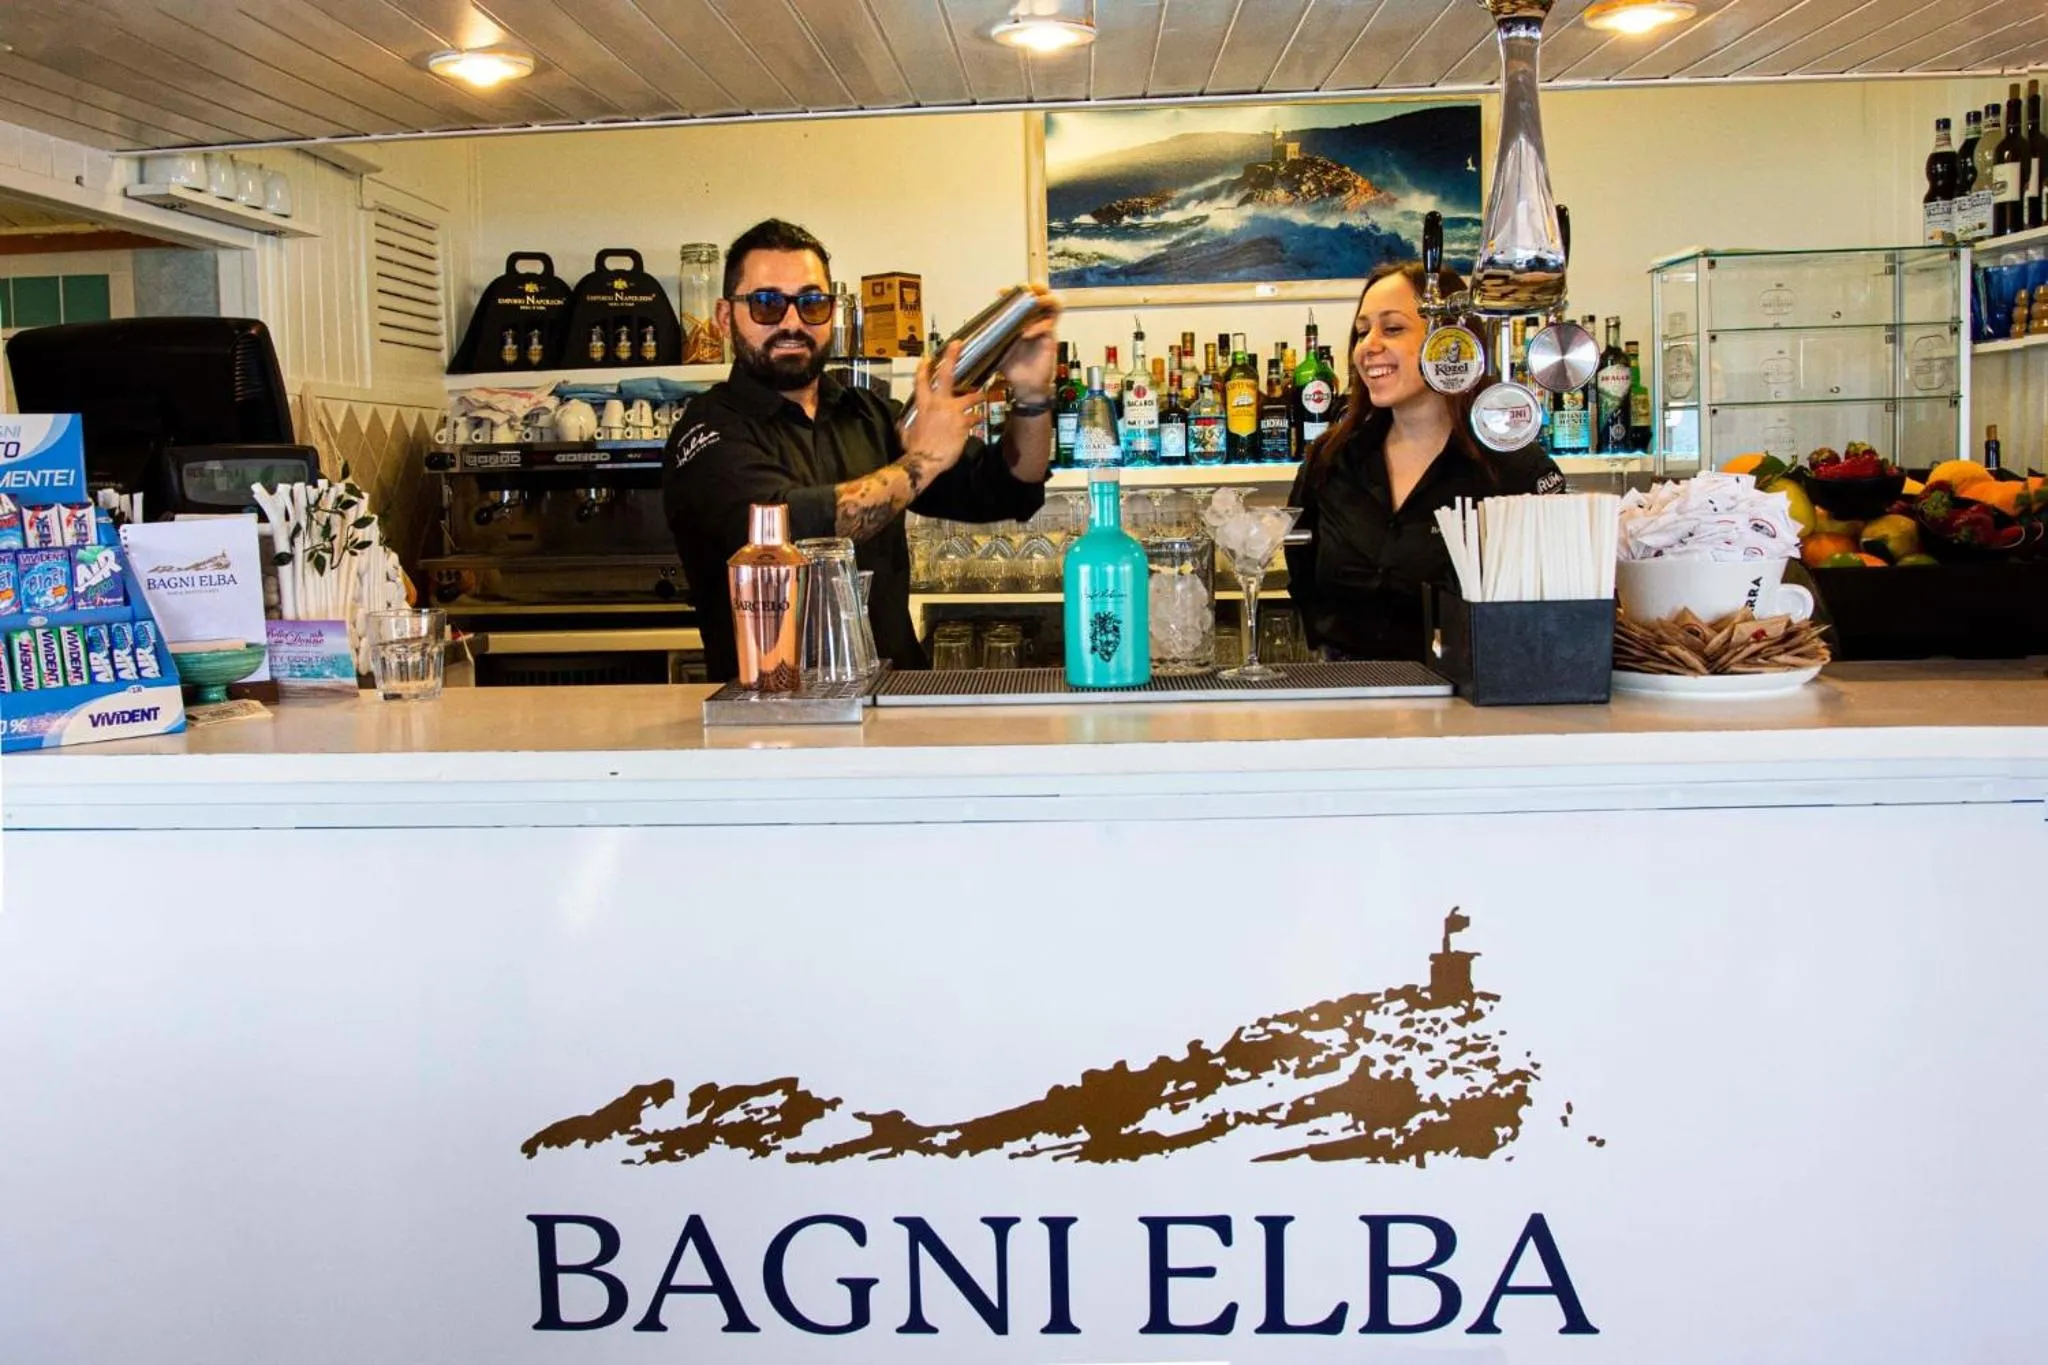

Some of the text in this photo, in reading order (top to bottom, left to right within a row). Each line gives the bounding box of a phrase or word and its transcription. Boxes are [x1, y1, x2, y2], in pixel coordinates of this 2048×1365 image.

[147, 573, 238, 590] BAGNI ELBA
[525, 1212, 1600, 1336] BAGNI ELBA
